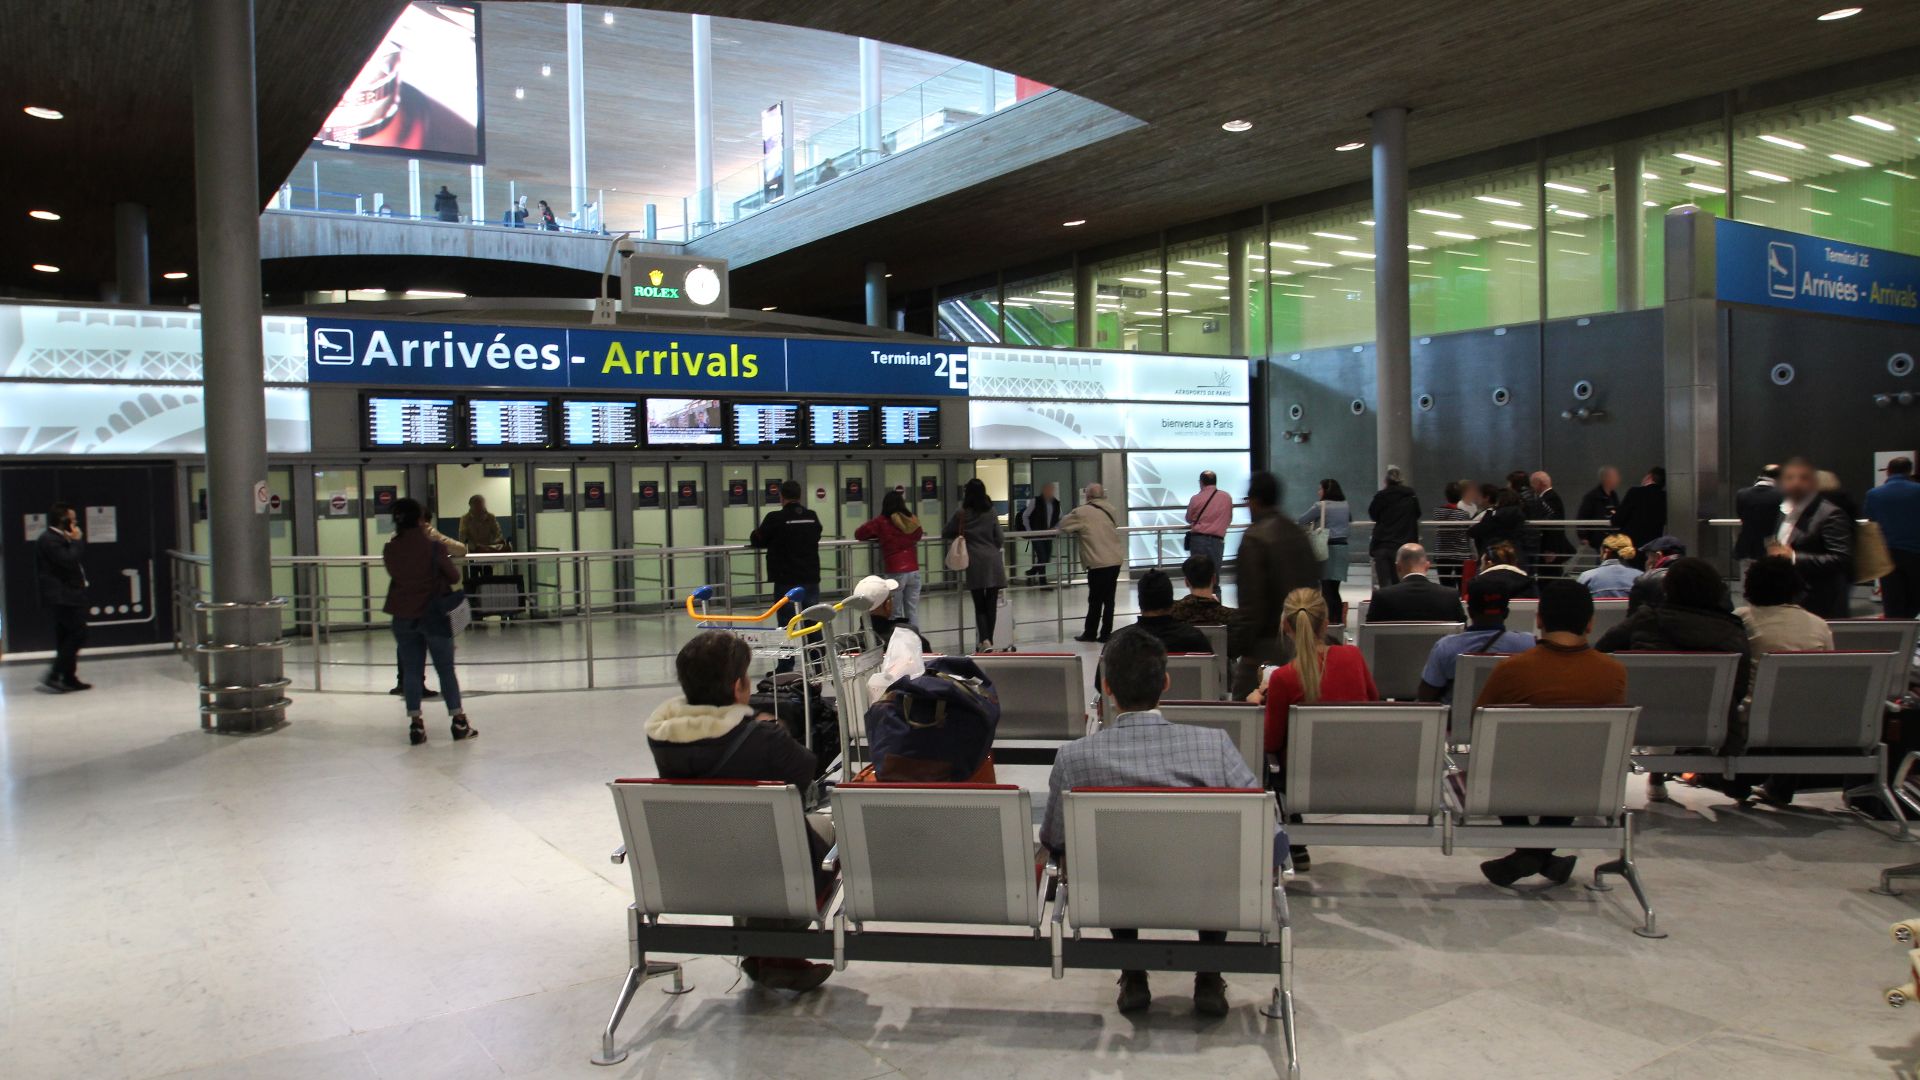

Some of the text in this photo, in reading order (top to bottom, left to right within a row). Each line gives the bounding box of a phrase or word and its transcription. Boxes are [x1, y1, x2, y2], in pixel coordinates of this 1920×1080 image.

[1825, 247, 1869, 267] Terminal 2E
[634, 286, 679, 298] ROLEX
[1801, 271, 1858, 302] Arrivées
[1870, 281, 1917, 308] Arrivals
[362, 330, 560, 370] Arrivées
[601, 341, 758, 378] Arrivals
[871, 351, 968, 389] Terminal 2E
[1162, 418, 1204, 428] bienvenue
[1213, 419, 1234, 429] Paris
